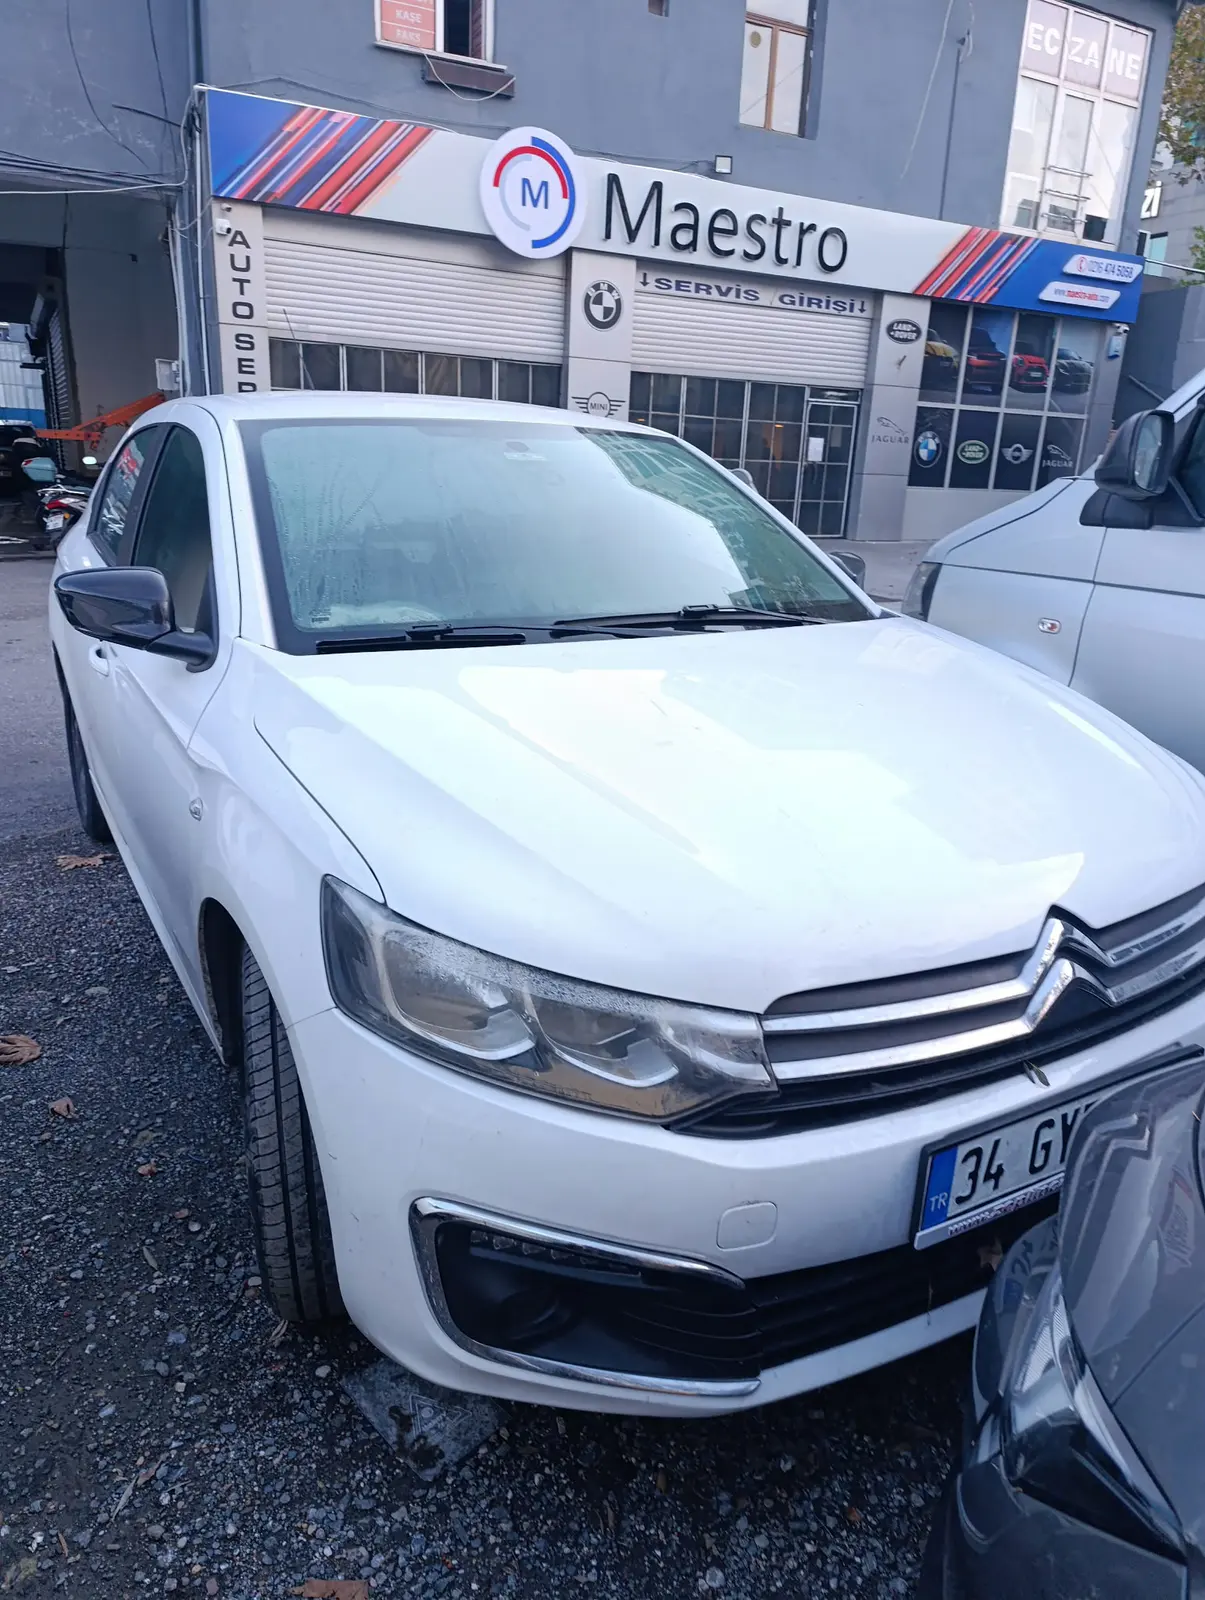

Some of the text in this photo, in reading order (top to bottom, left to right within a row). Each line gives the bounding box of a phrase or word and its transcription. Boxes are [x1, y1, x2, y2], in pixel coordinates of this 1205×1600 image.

[521, 178, 548, 209] M
[603, 173, 848, 273] Maestro
[228, 230, 254, 320] AUTO
[654, 277, 855, 314] SERVİS GİRİŞİ
[893, 322, 912, 332] LAND
[894, 330, 918, 340] ROVER
[590, 402, 608, 411] MINI
[871, 434, 910, 445] JAGUAR
[1042, 459, 1074, 468] JAGUAR
[955, 1138, 1005, 1206] 34
[1029, 1098, 1100, 1176] GY
[930, 1192, 949, 1213] TR
